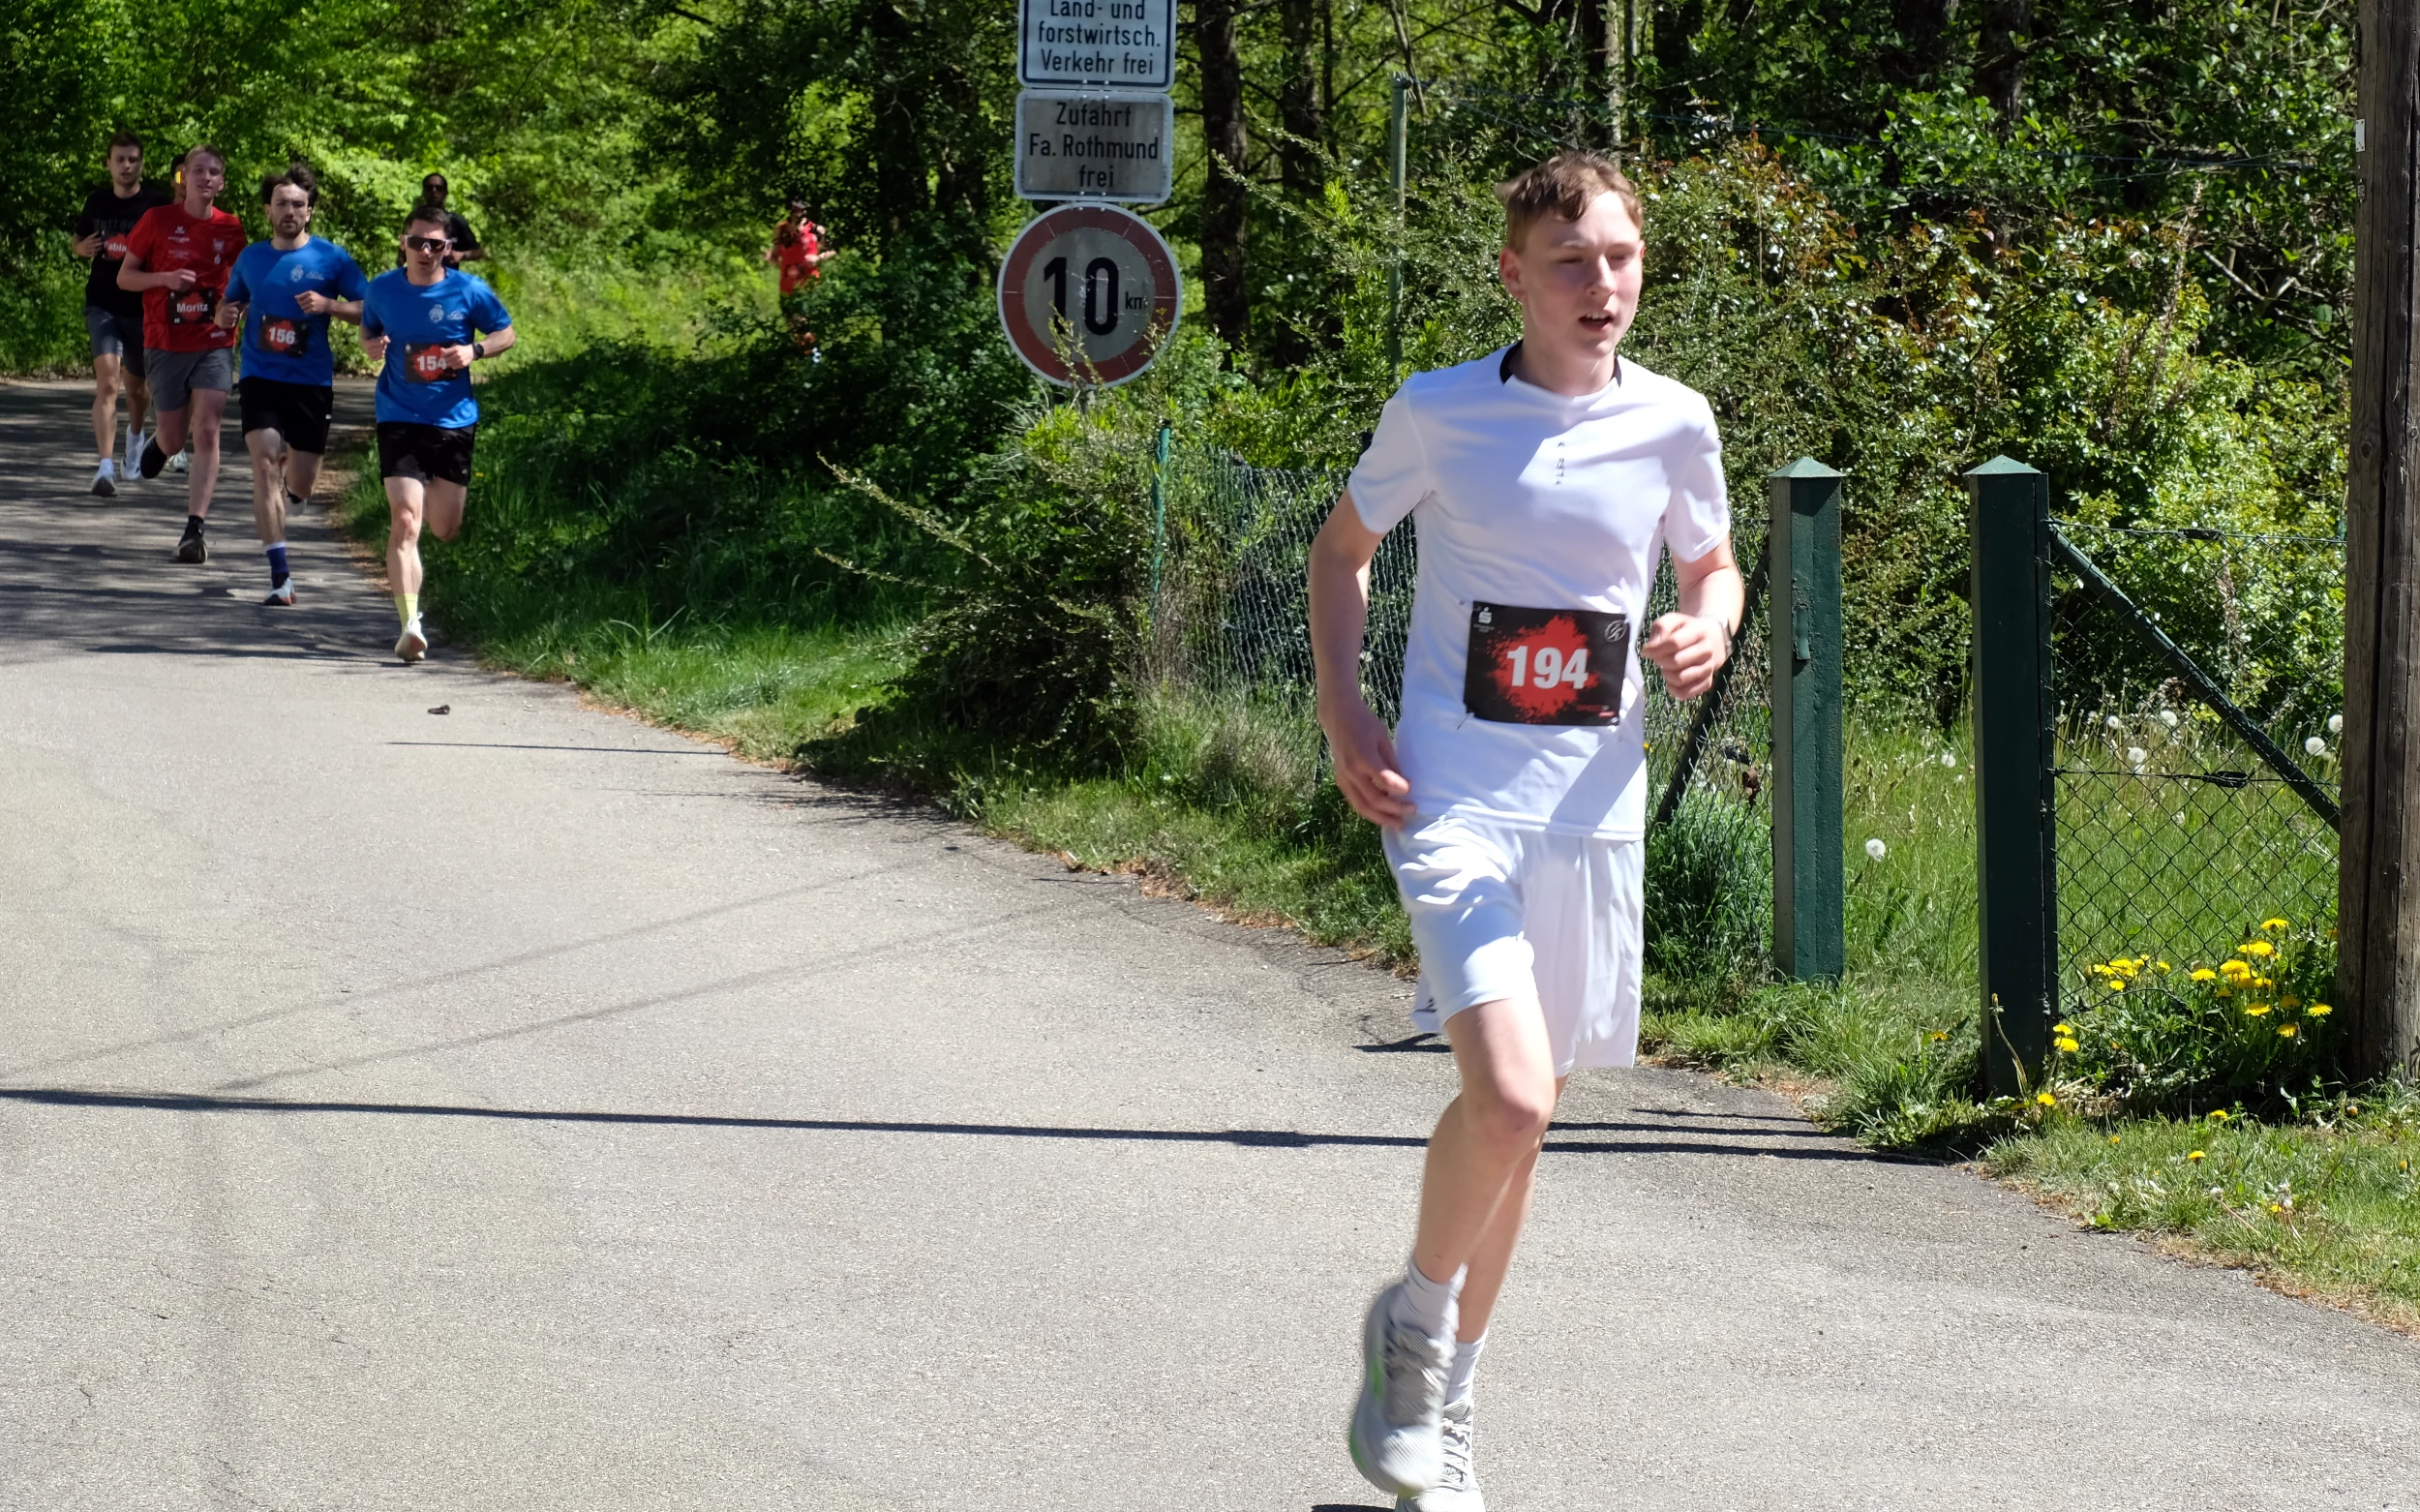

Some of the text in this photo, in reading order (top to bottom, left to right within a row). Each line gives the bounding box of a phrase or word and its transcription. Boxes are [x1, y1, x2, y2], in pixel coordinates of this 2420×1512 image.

[1050, 0, 1145, 19] Land- und
[1038, 20, 1161, 47] forstwirtsch.
[1041, 48, 1153, 75] Verkehr frei
[1056, 102, 1132, 127] Zufahrt
[1029, 133, 1159, 160] Fa. Rothmund
[1079, 165, 1114, 188] frei
[176, 302, 209, 313] Moritz
[1044, 257, 1119, 336] 10
[268, 326, 296, 345] 156
[417, 355, 447, 371] 154
[1506, 645, 1588, 689] 194
